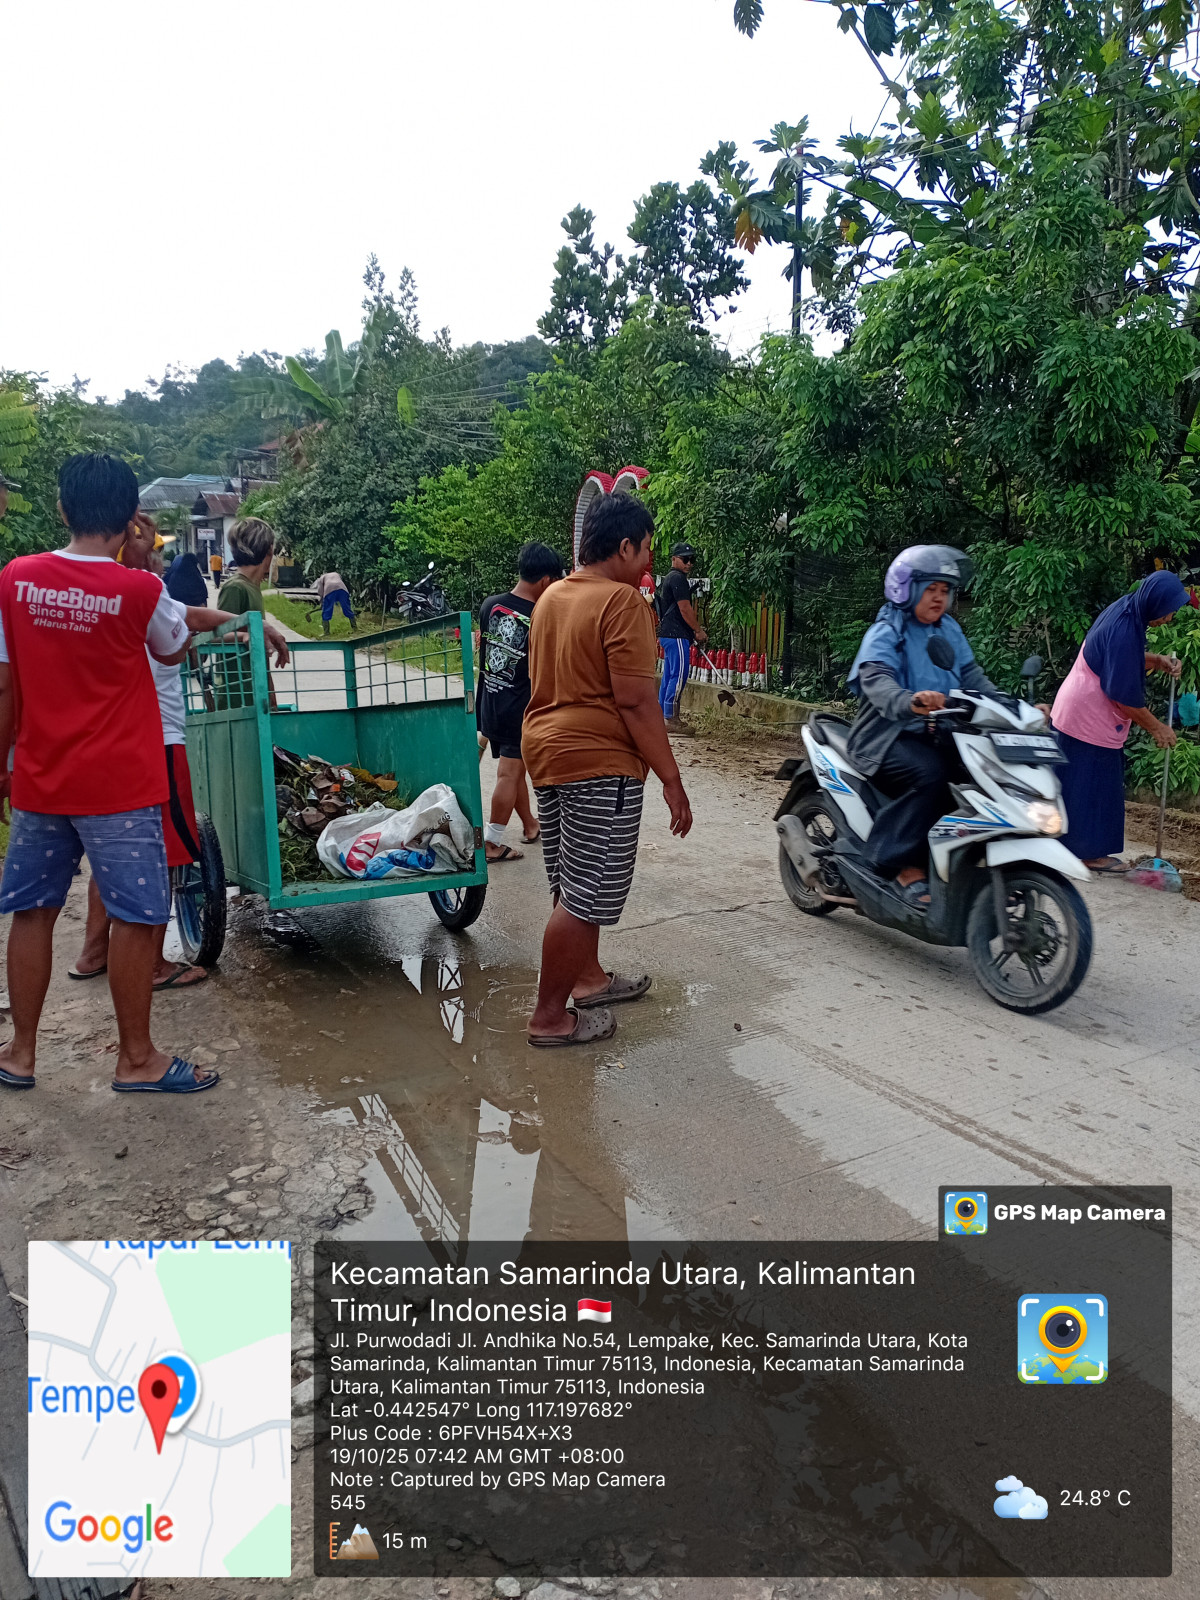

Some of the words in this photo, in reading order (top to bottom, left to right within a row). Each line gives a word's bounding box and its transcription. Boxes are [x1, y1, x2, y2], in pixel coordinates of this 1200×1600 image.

[14, 580, 122, 616] ThreeBond
[28, 604, 65, 619] Since
[68, 609, 99, 624] 1955
